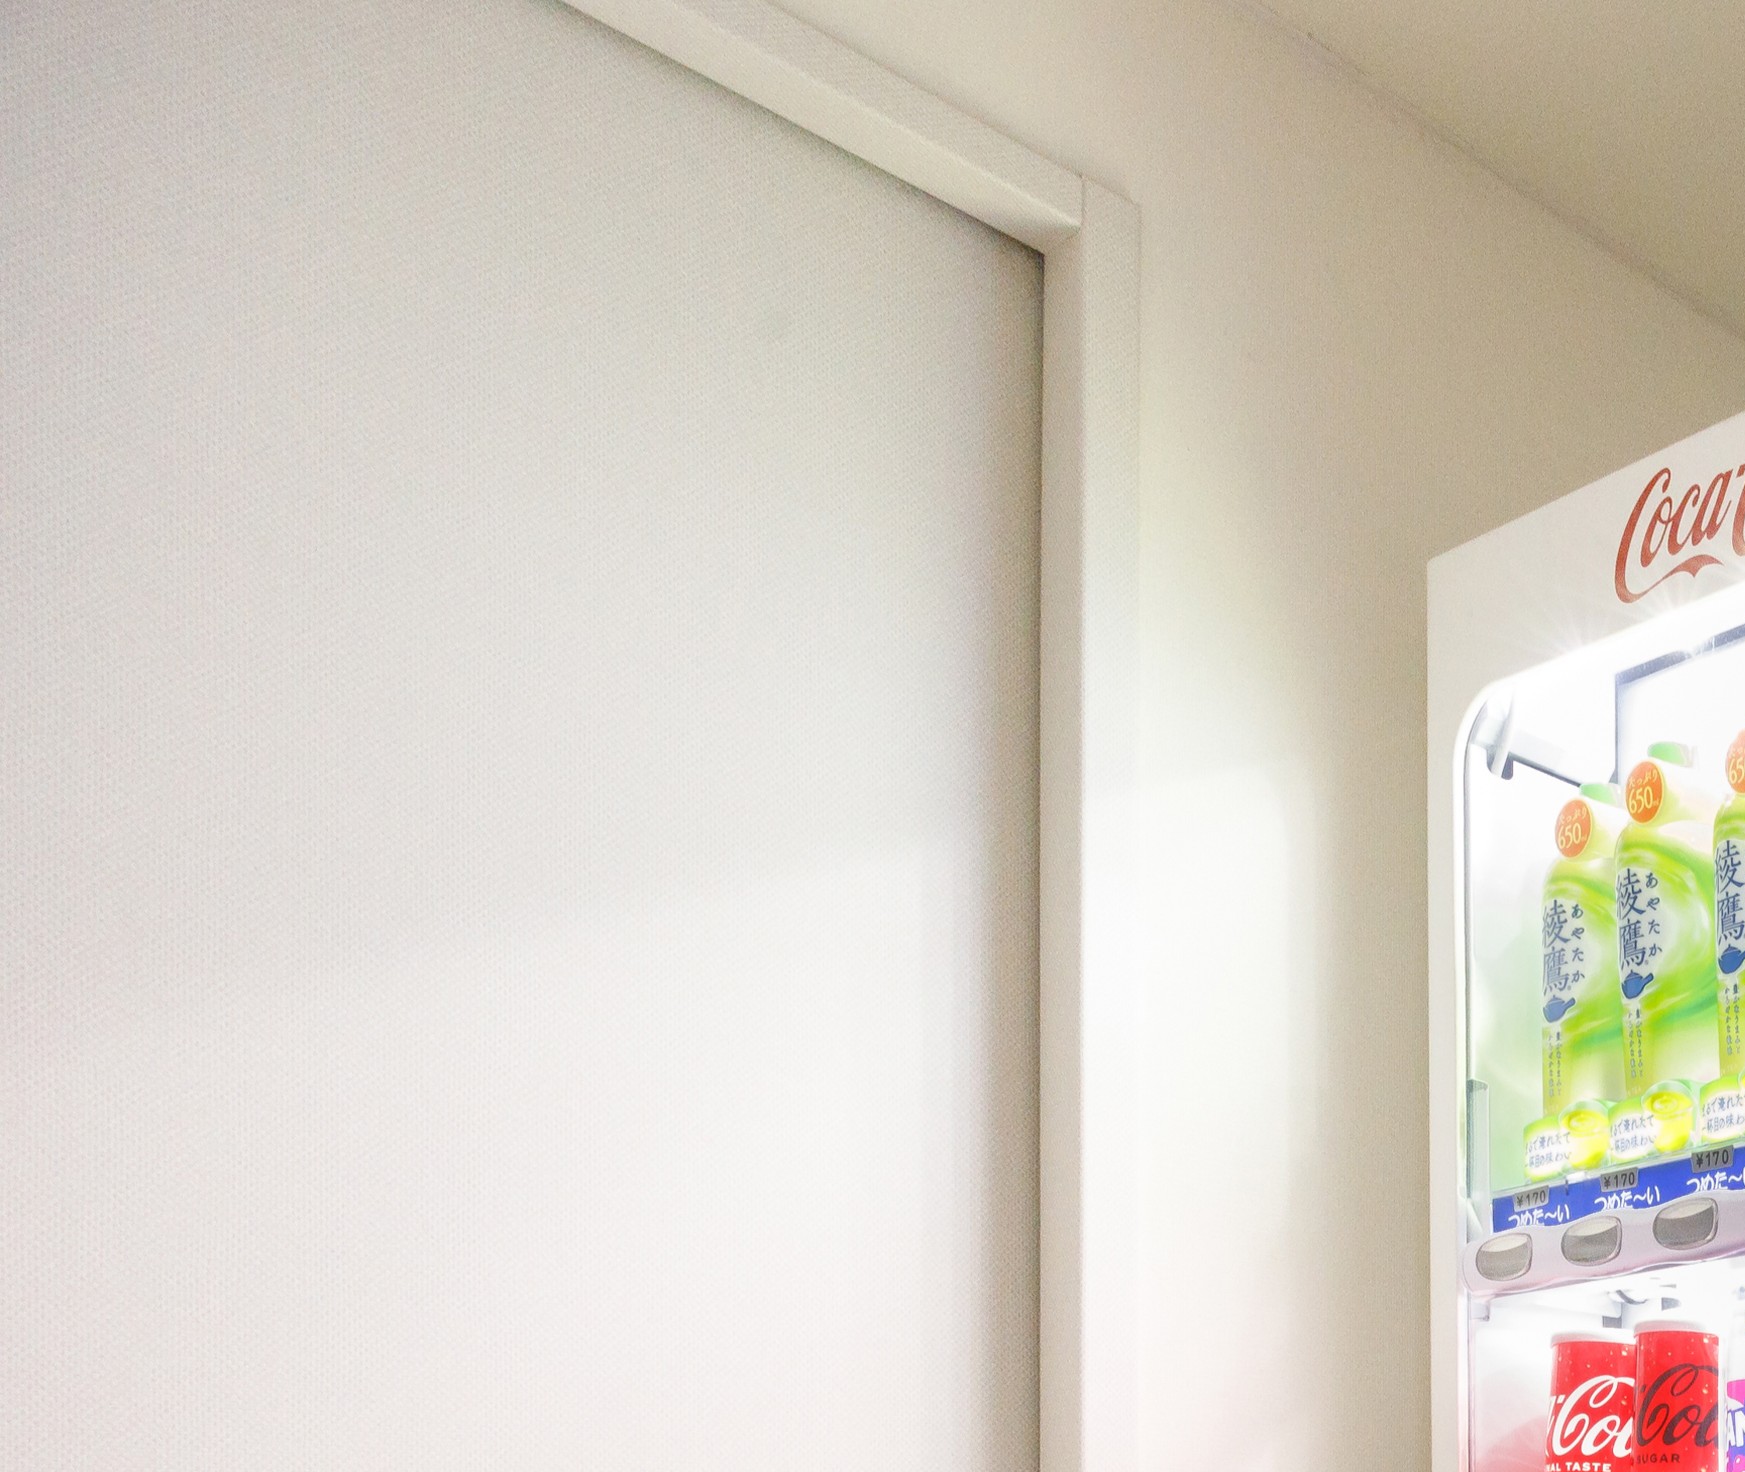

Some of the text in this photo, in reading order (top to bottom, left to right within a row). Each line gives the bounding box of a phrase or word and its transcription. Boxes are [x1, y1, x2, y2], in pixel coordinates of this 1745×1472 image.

[1615, 868, 1647, 968] 綾鷹
[1645, 872, 1663, 958] あやたか
[1714, 840, 1745, 943] 綾鷹
[1541, 899, 1571, 993] 綾鷹
[1571, 903, 1586, 983] あやたか
[1603, 1171, 1635, 1188] ¥170
[1696, 1149, 1729, 1168] ¥170
[1516, 1190, 1546, 1208] ¥170
[1565, 1463, 1612, 1472] TASTE
